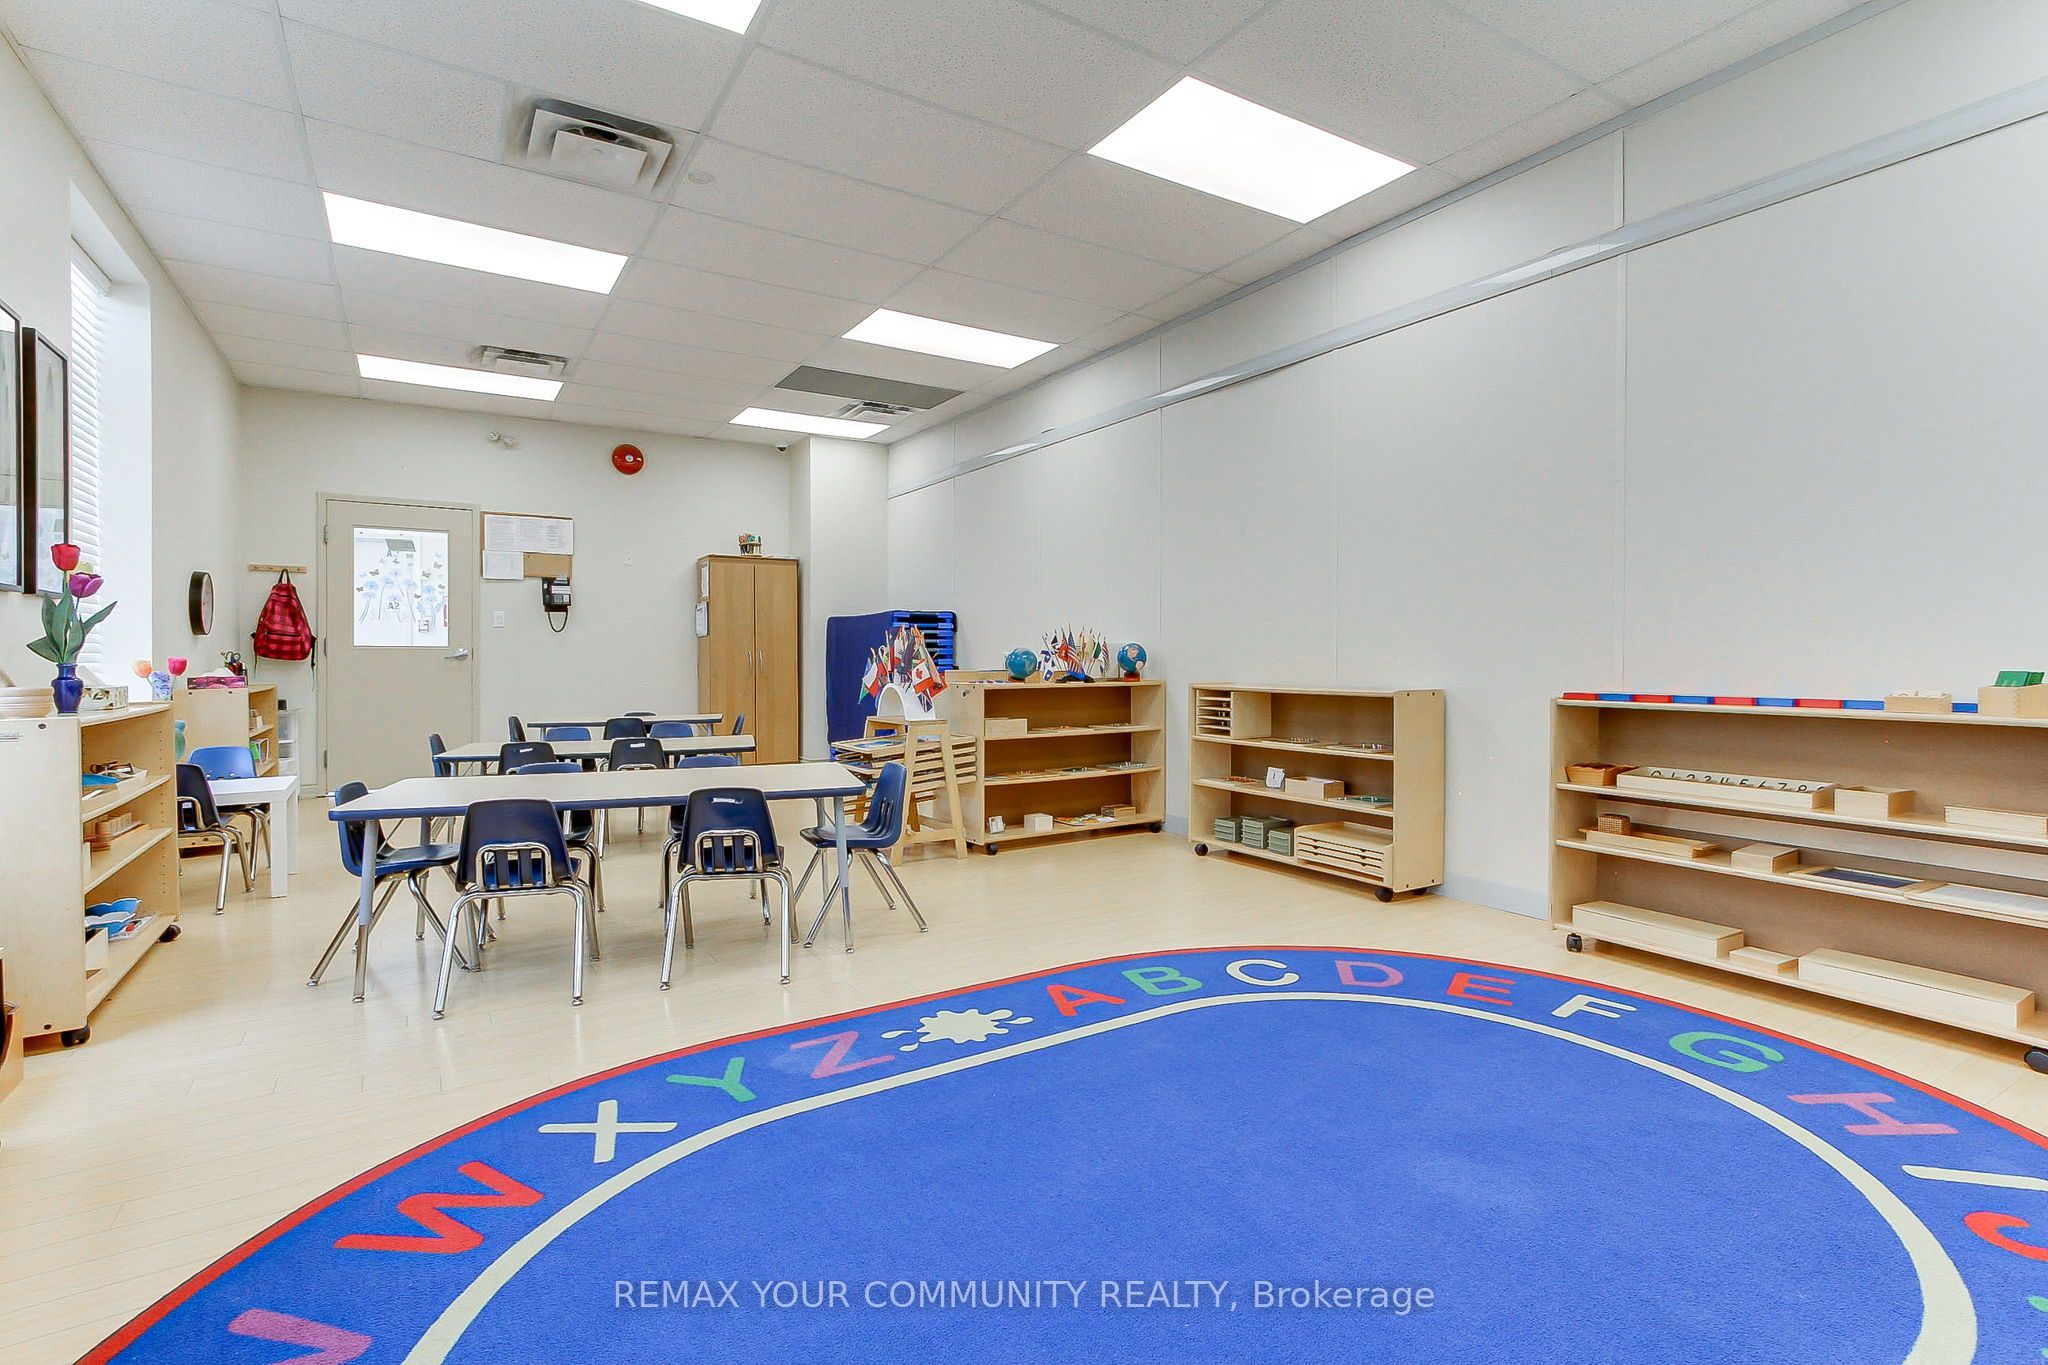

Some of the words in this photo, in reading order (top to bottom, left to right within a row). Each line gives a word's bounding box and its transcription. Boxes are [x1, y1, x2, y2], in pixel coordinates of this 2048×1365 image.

[333, 1160, 544, 1254] W
[538, 1099, 678, 1163] X
[665, 1057, 756, 1102] Y
[789, 1031, 894, 1079] Z
[1046, 984, 1126, 1016] A
[1121, 966, 1202, 995] B
[1225, 959, 1300, 986] C
[1335, 960, 1404, 987] D
[1446, 972, 1517, 1006] E
[1551, 994, 1637, 1018] F
[1669, 1031, 1785, 1073] G
[1787, 1092, 1959, 1135] H
